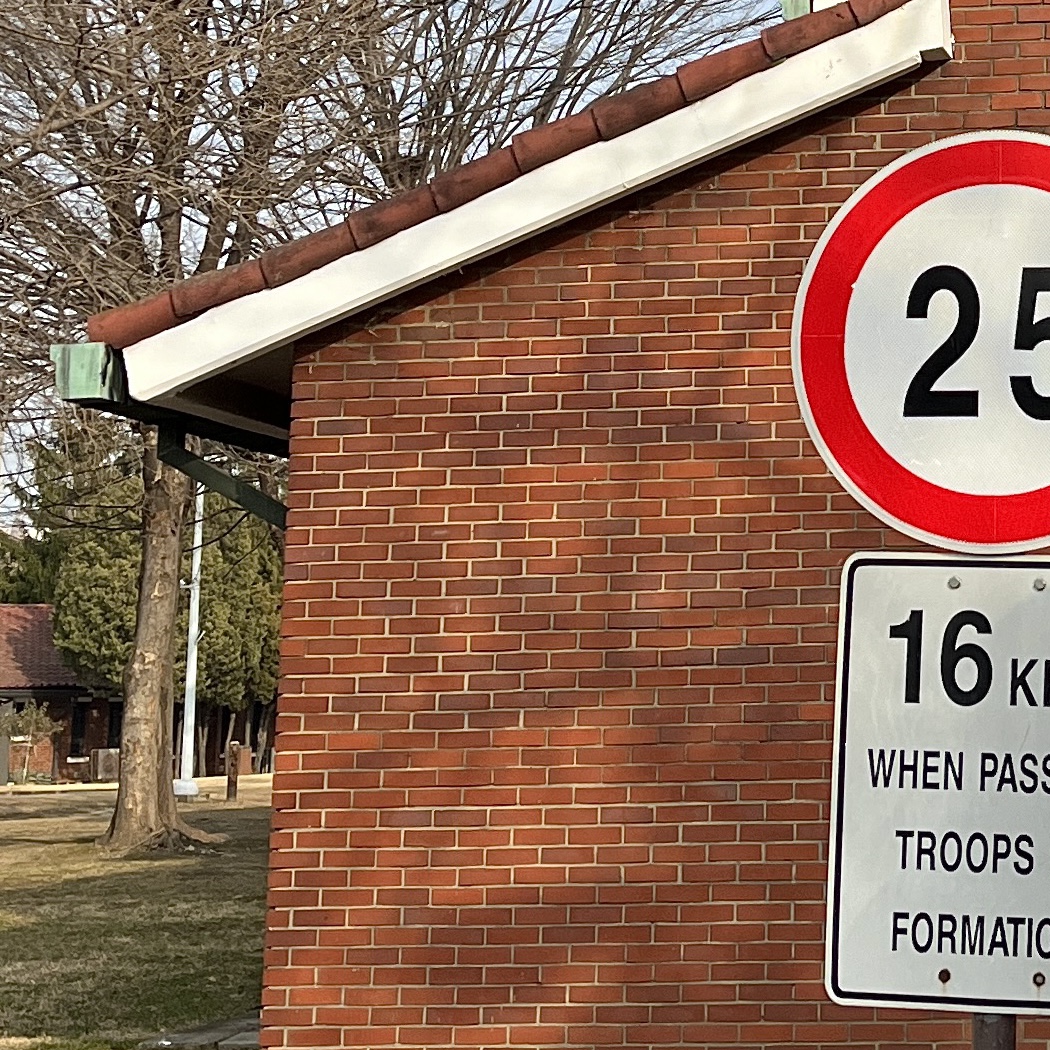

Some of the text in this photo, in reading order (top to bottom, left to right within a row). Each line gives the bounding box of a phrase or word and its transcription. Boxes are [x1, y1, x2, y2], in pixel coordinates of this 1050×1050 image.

[889, 609, 993, 707] 16
[867, 748, 964, 791] WHEN
[895, 829, 1035, 876] TROOPS
